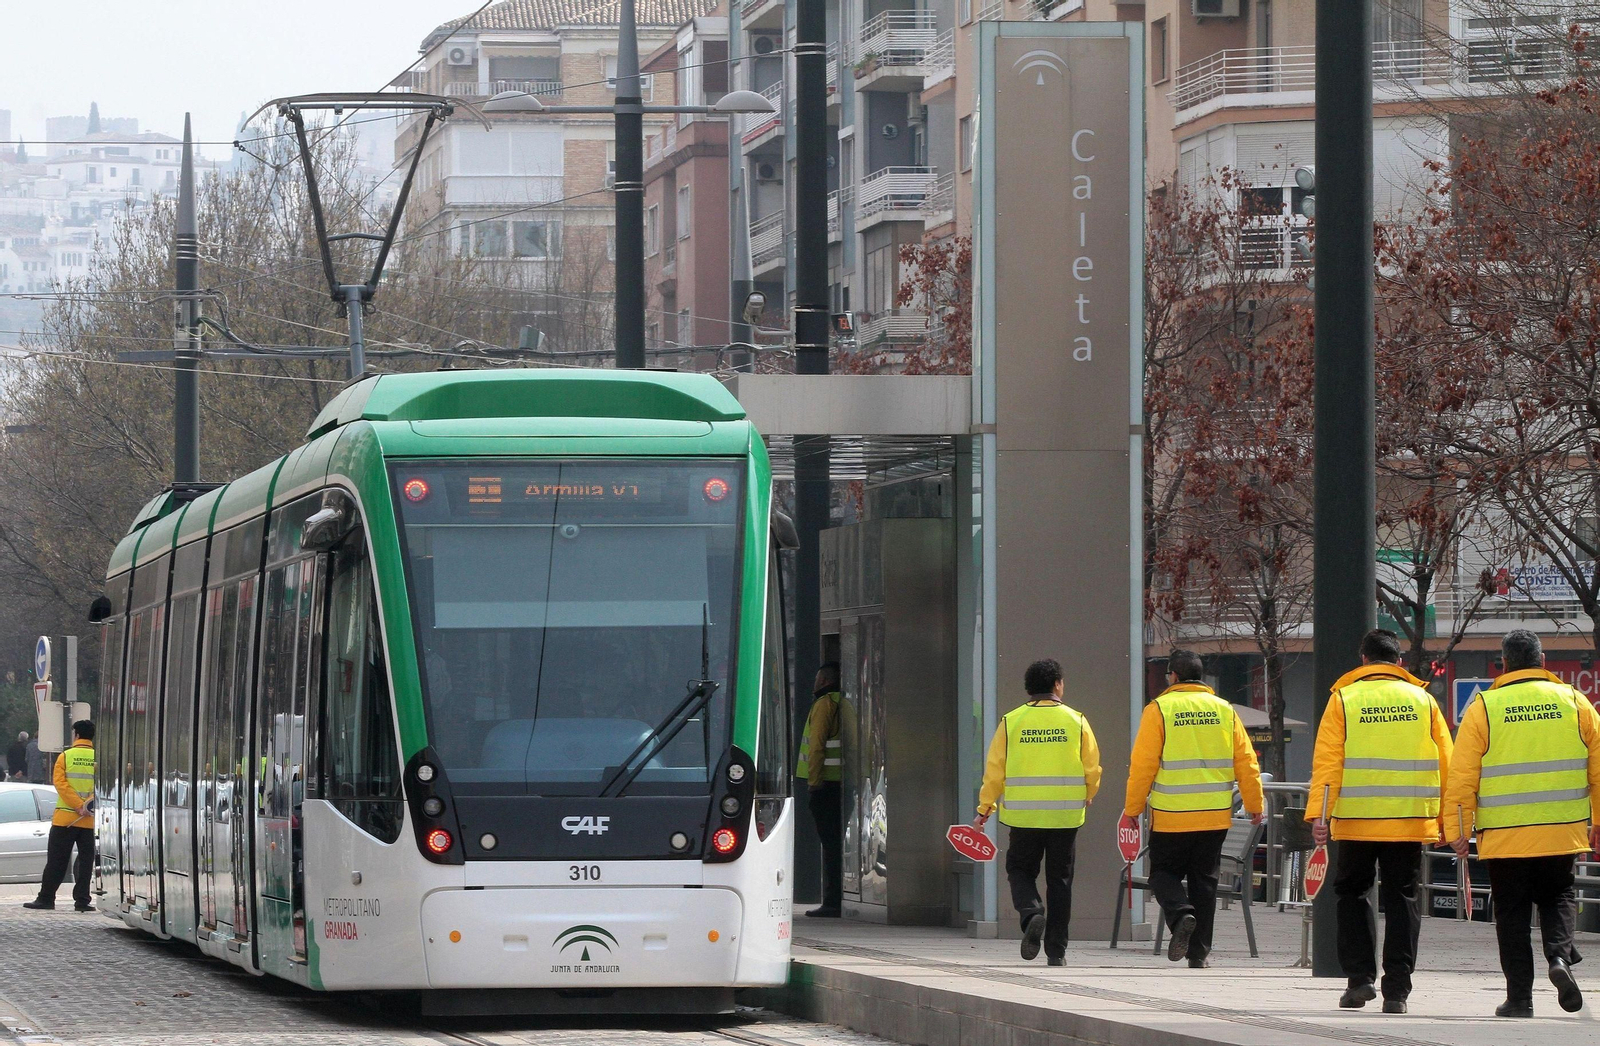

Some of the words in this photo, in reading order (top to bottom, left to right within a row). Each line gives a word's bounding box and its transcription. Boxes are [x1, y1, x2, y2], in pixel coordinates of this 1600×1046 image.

[1071, 128, 1096, 362] Caleta
[525, 481, 604, 500] Armilla
[1539, 565, 1549, 574] de
[1361, 705, 1414, 715] SERVICIOS
[1505, 703, 1558, 714] SERVICIOS
[1175, 711, 1217, 719] SERVICIOS
[1359, 714, 1418, 723] AUXILIARES
[1503, 711, 1562, 723] AUXILIARES
[1173, 718, 1221, 727] AUXILIARES
[1021, 728, 1066, 736] SERVICIOS
[1019, 735, 1068, 744] AUXILIARES
[561, 816, 610, 835] CAF
[1119, 827, 1139, 844] STOP
[952, 833, 992, 856] STOP
[569, 865, 602, 881] 310
[1306, 863, 1325, 881] STOP
[323, 897, 381, 917] METROPOLITANO
[324, 921, 359, 940] GRANADA
[550, 965, 571, 973] JUNTA
[574, 965, 582, 973] DE
[585, 965, 620, 973] ANDALUCIA
